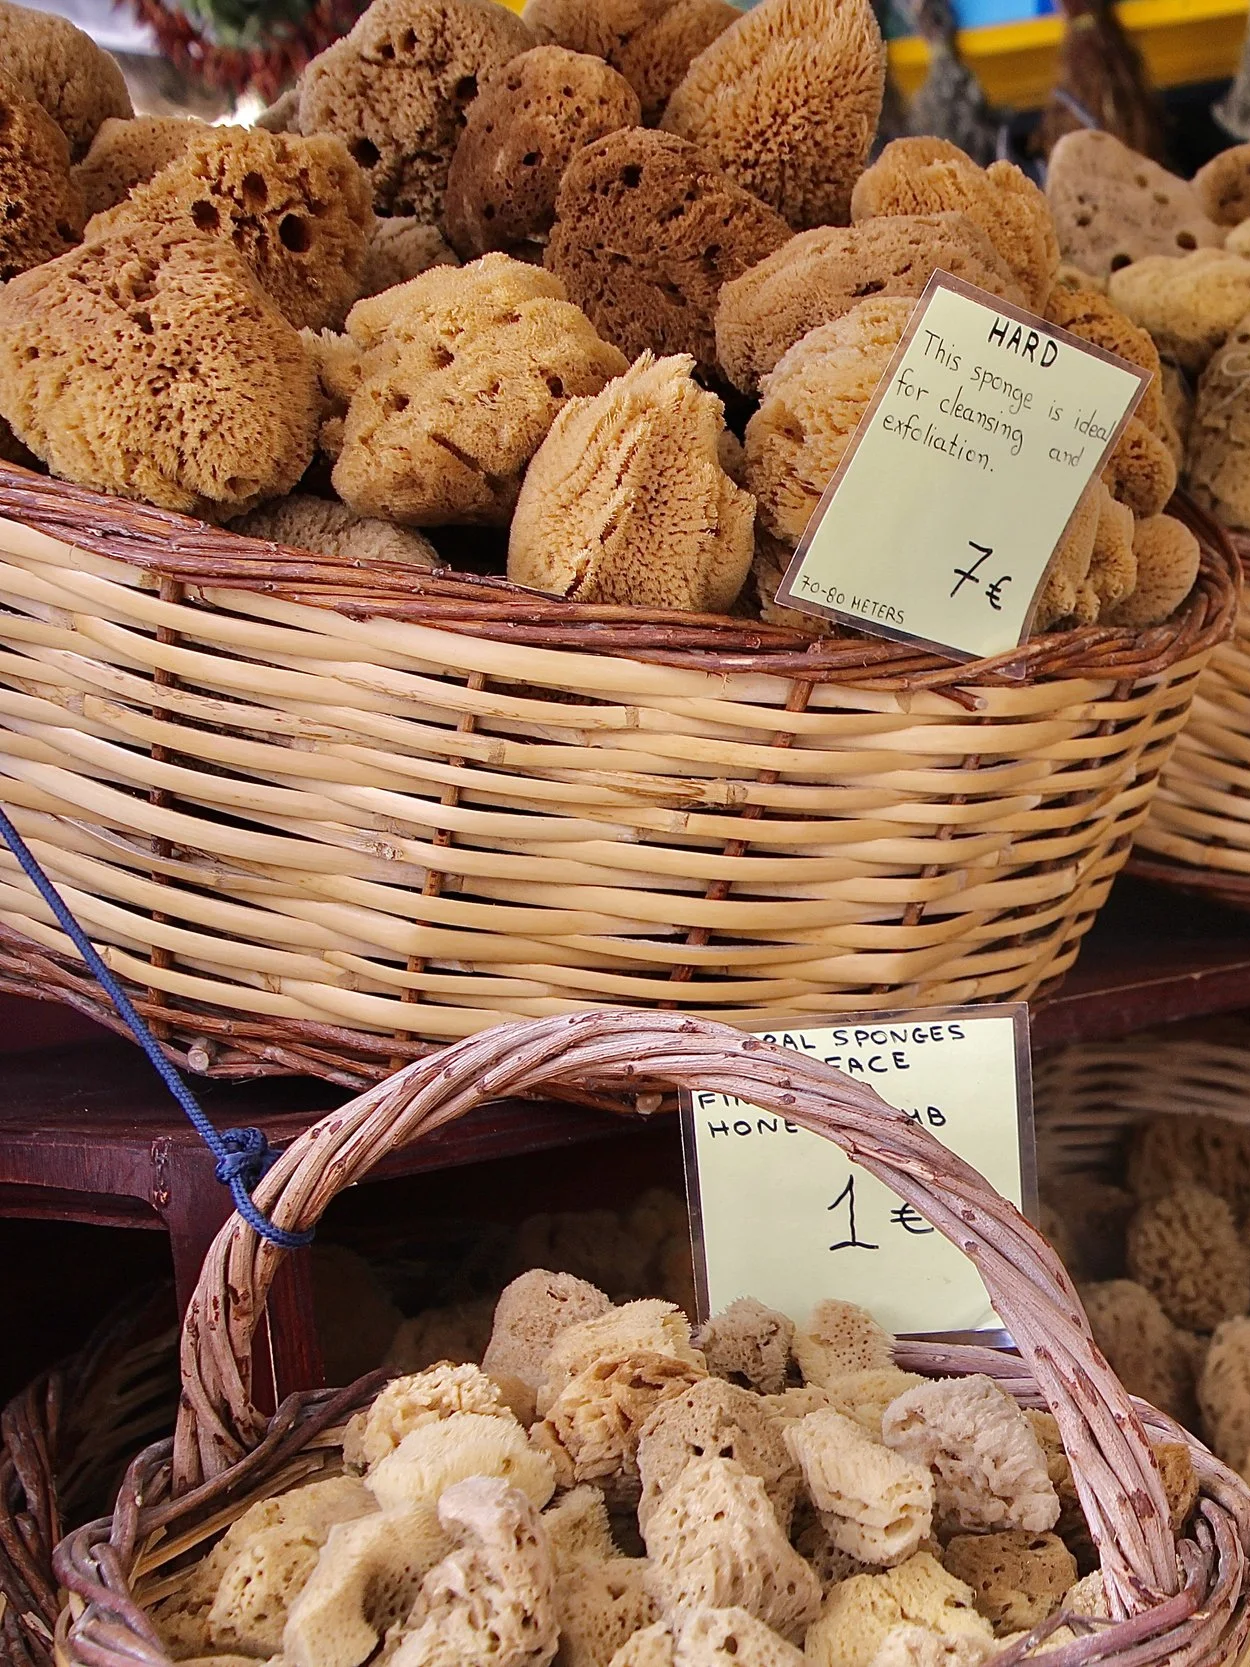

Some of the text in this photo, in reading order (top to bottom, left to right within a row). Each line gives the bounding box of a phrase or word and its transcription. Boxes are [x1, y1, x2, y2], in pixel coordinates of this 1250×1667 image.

[988, 317, 1058, 367] HARD
[924, 329, 1117, 442] This sponge is ideal
[884, 414, 994, 472] exfoliation.
[897, 368, 1081, 467] for cleansing and
[801, 575, 845, 605] 70-80
[951, 541, 1011, 609] 7€
[825, 1051, 910, 1073] FACE
[833, 1025, 966, 1047] SPONGES
